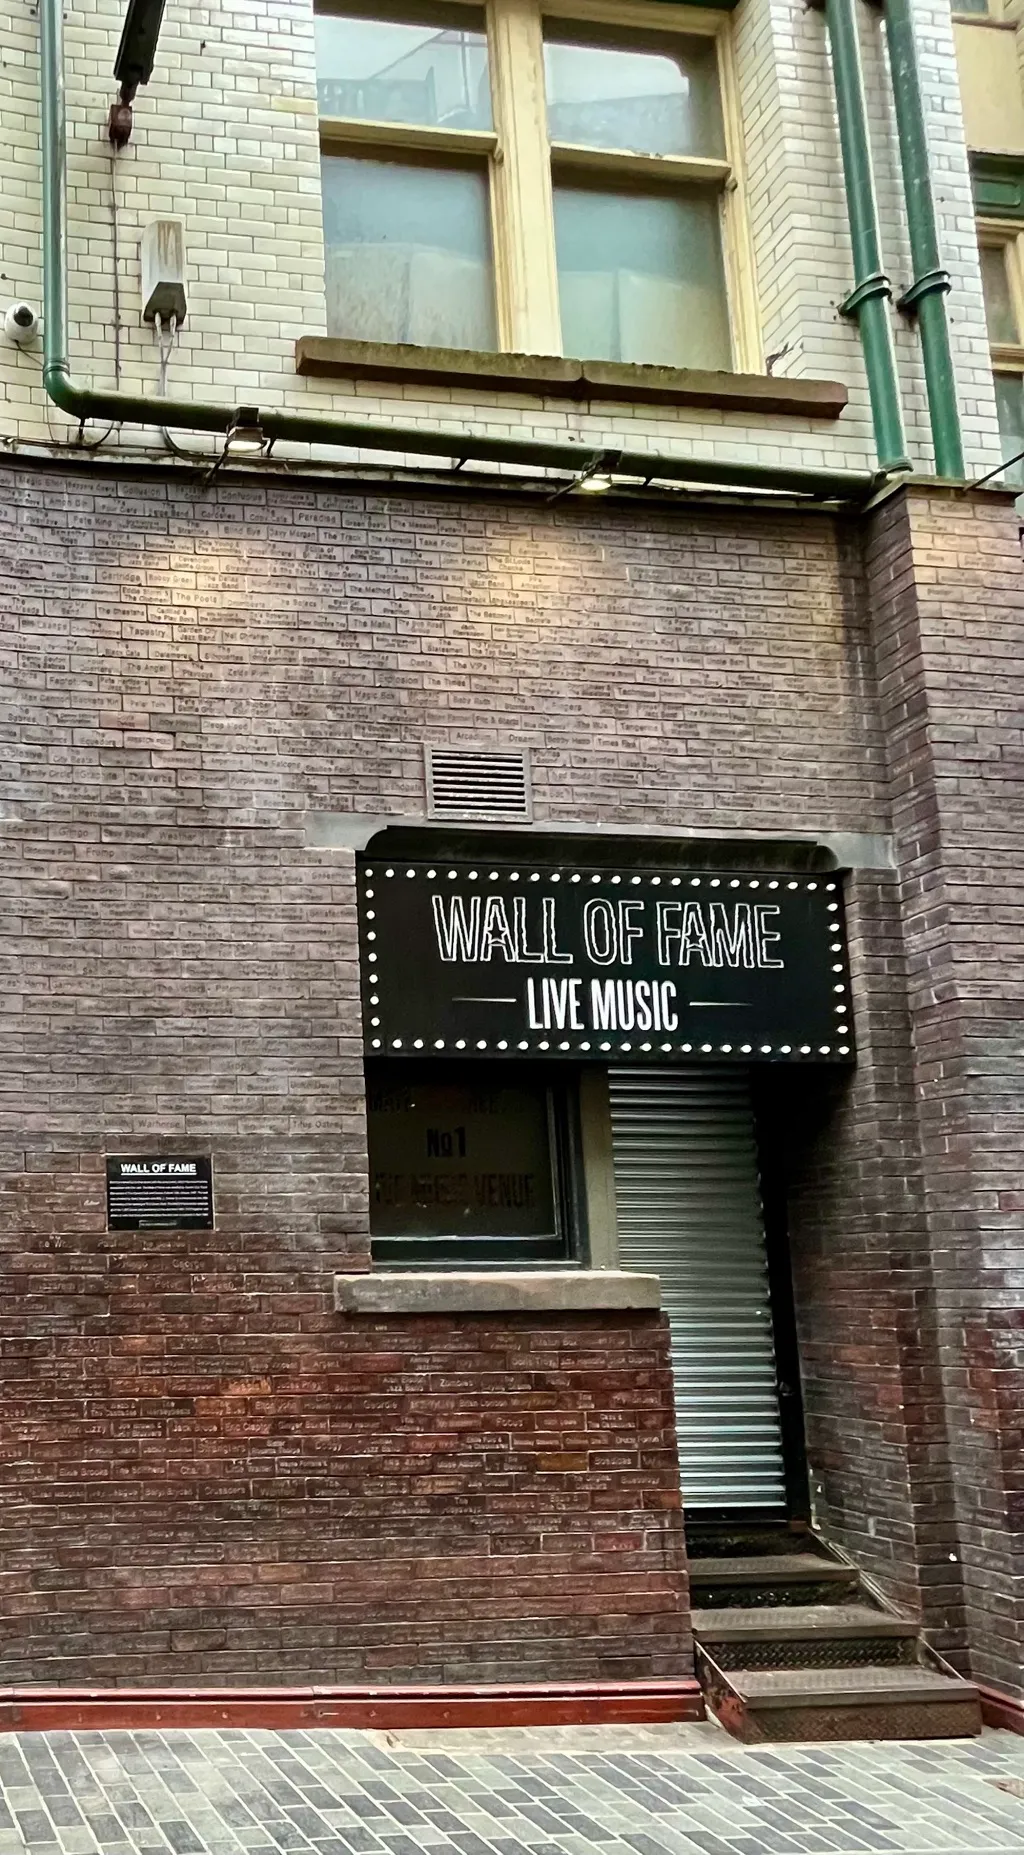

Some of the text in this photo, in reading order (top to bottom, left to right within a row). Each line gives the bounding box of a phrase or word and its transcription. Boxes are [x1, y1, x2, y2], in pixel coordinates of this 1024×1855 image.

[323, 532, 337, 540] The
[101, 571, 141, 582] Cartridge
[130, 627, 165, 638] Tapestry
[428, 677, 441, 686] The
[432, 895, 785, 969] WALL OF FAME
[527, 977, 679, 1031] LIVE MUSIC
[120, 1163, 197, 1173] WALL OF FAME
[496, 1418, 523, 1427] Focus
